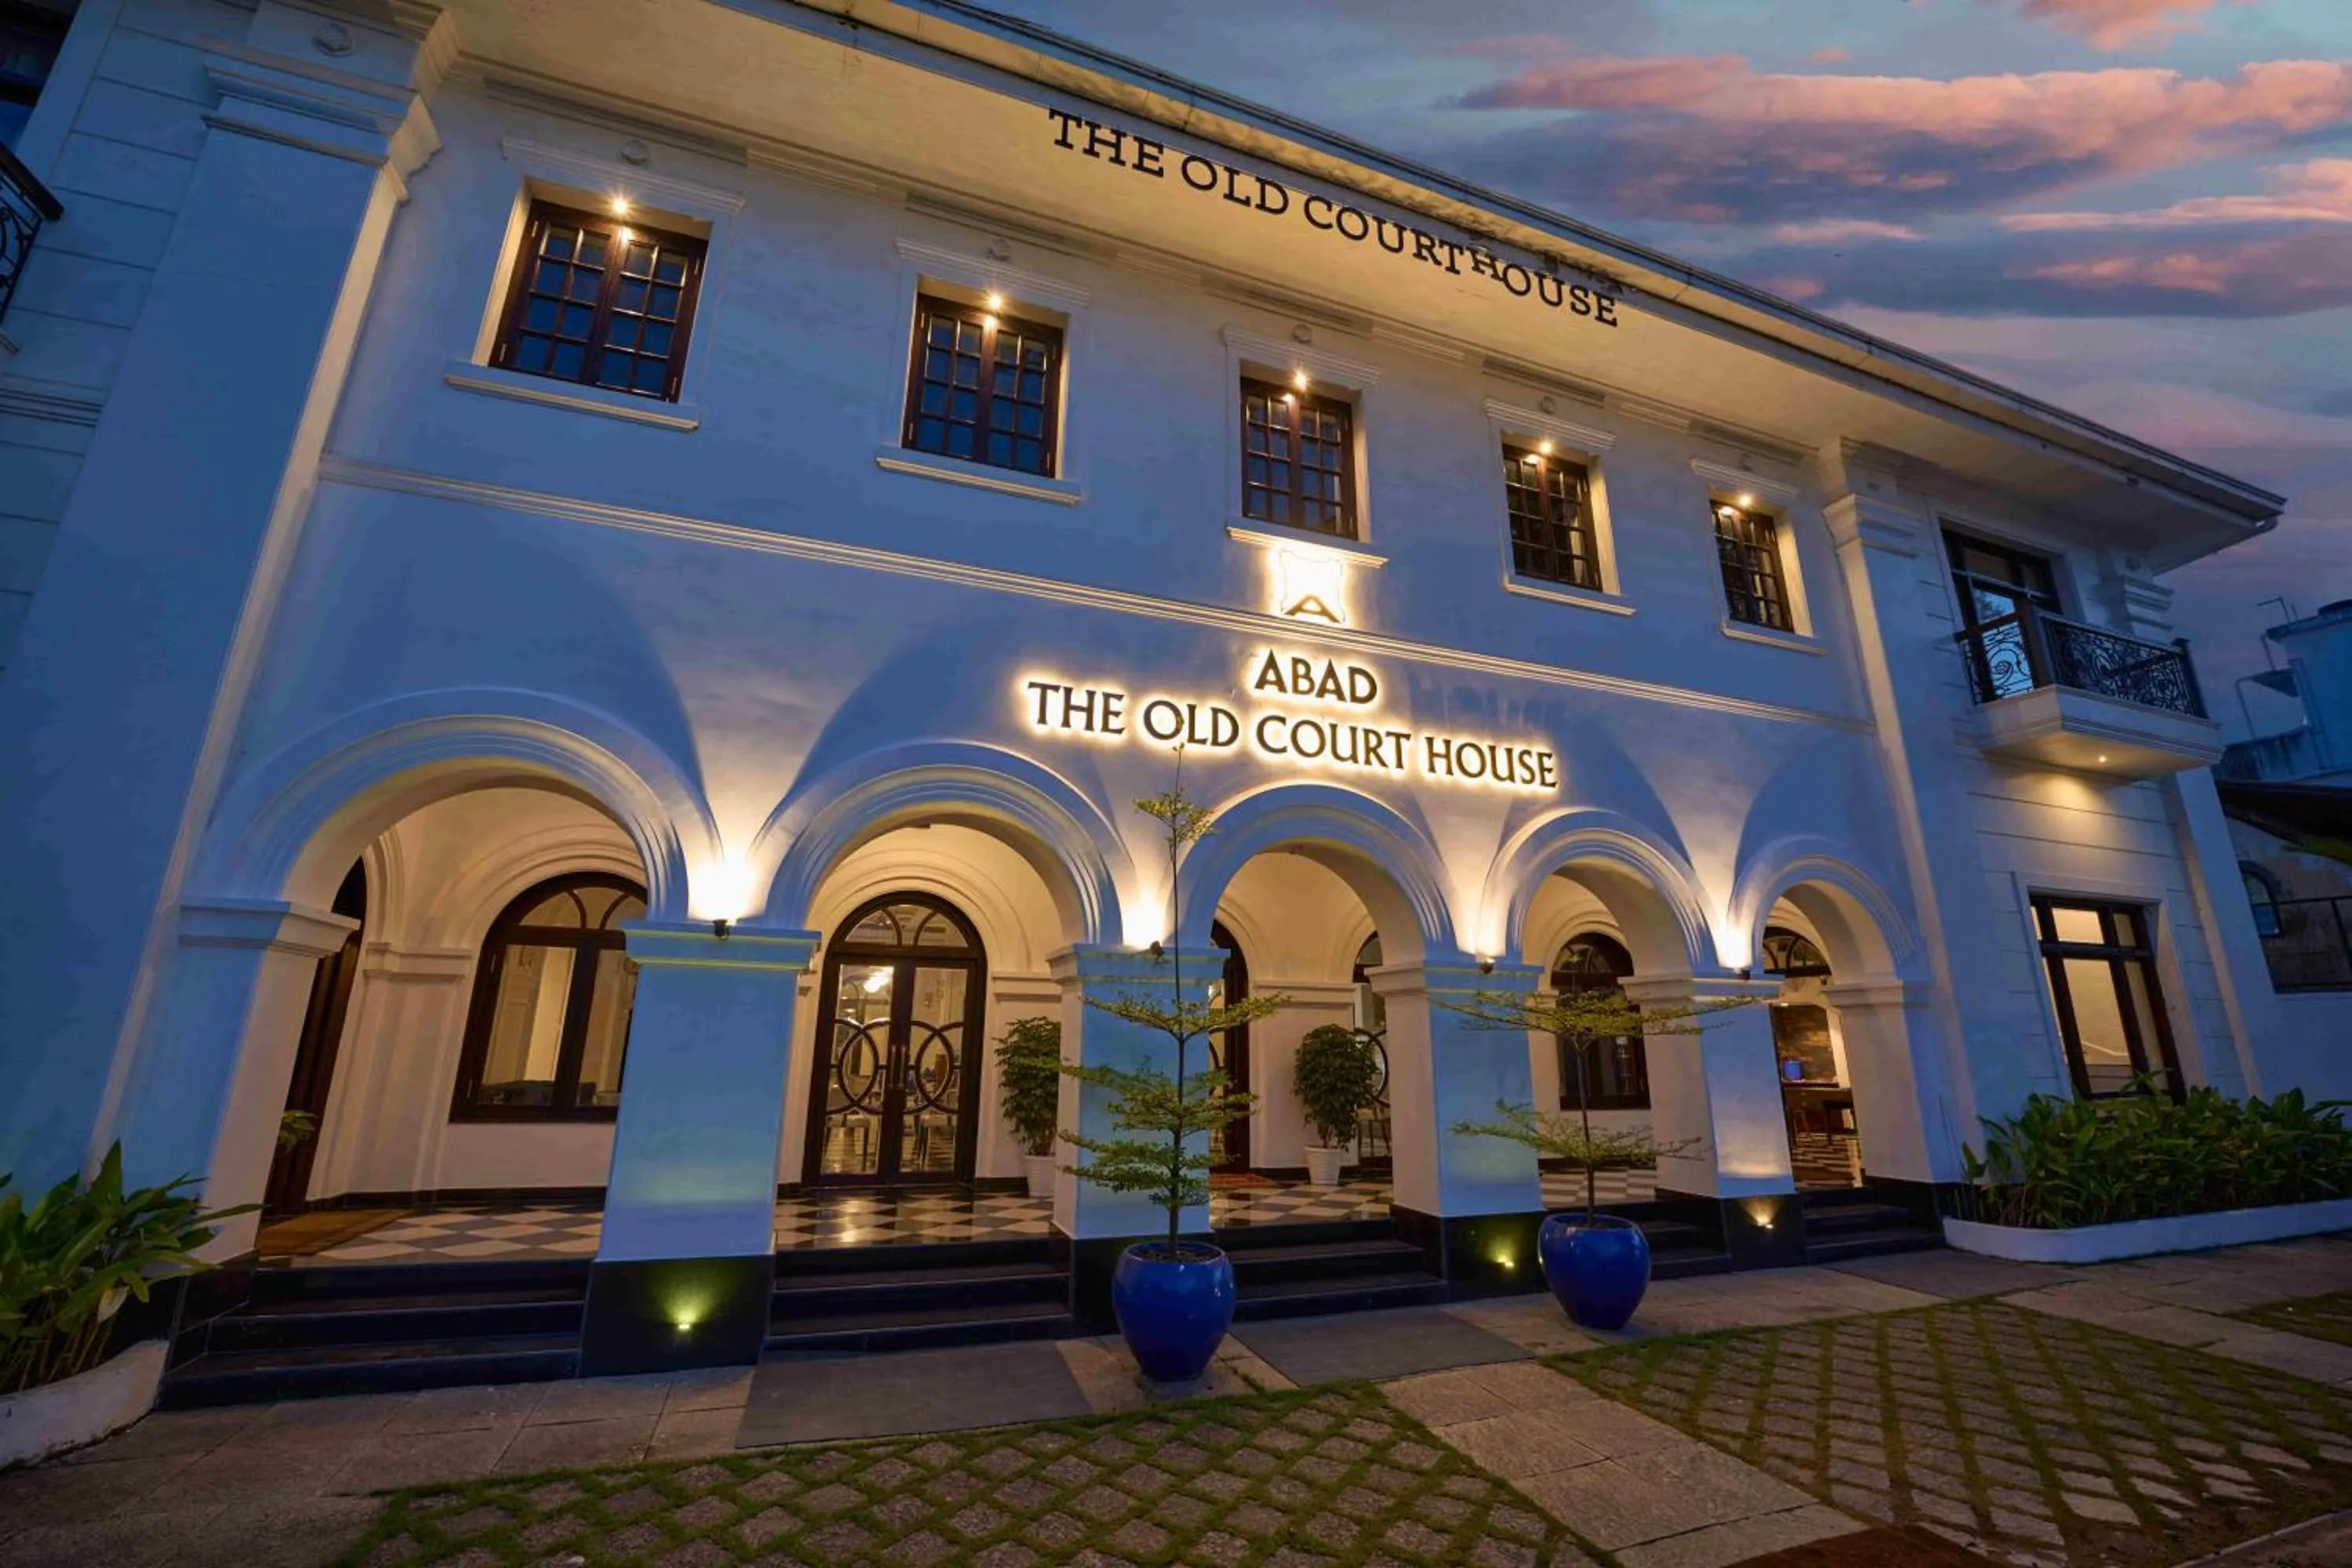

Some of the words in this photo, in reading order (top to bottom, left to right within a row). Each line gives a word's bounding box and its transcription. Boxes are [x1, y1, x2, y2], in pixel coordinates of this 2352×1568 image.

[1050, 109, 1165, 177] THE
[1181, 154, 1290, 216] OLD
[1303, 195, 1619, 327] COURTHOUSE
[1254, 649, 1377, 704] ABAD
[1027, 681, 1126, 735] THE
[1142, 700, 1240, 747] OLD
[1255, 715, 1411, 770] COURT
[1425, 735, 1558, 789] HOUSE
